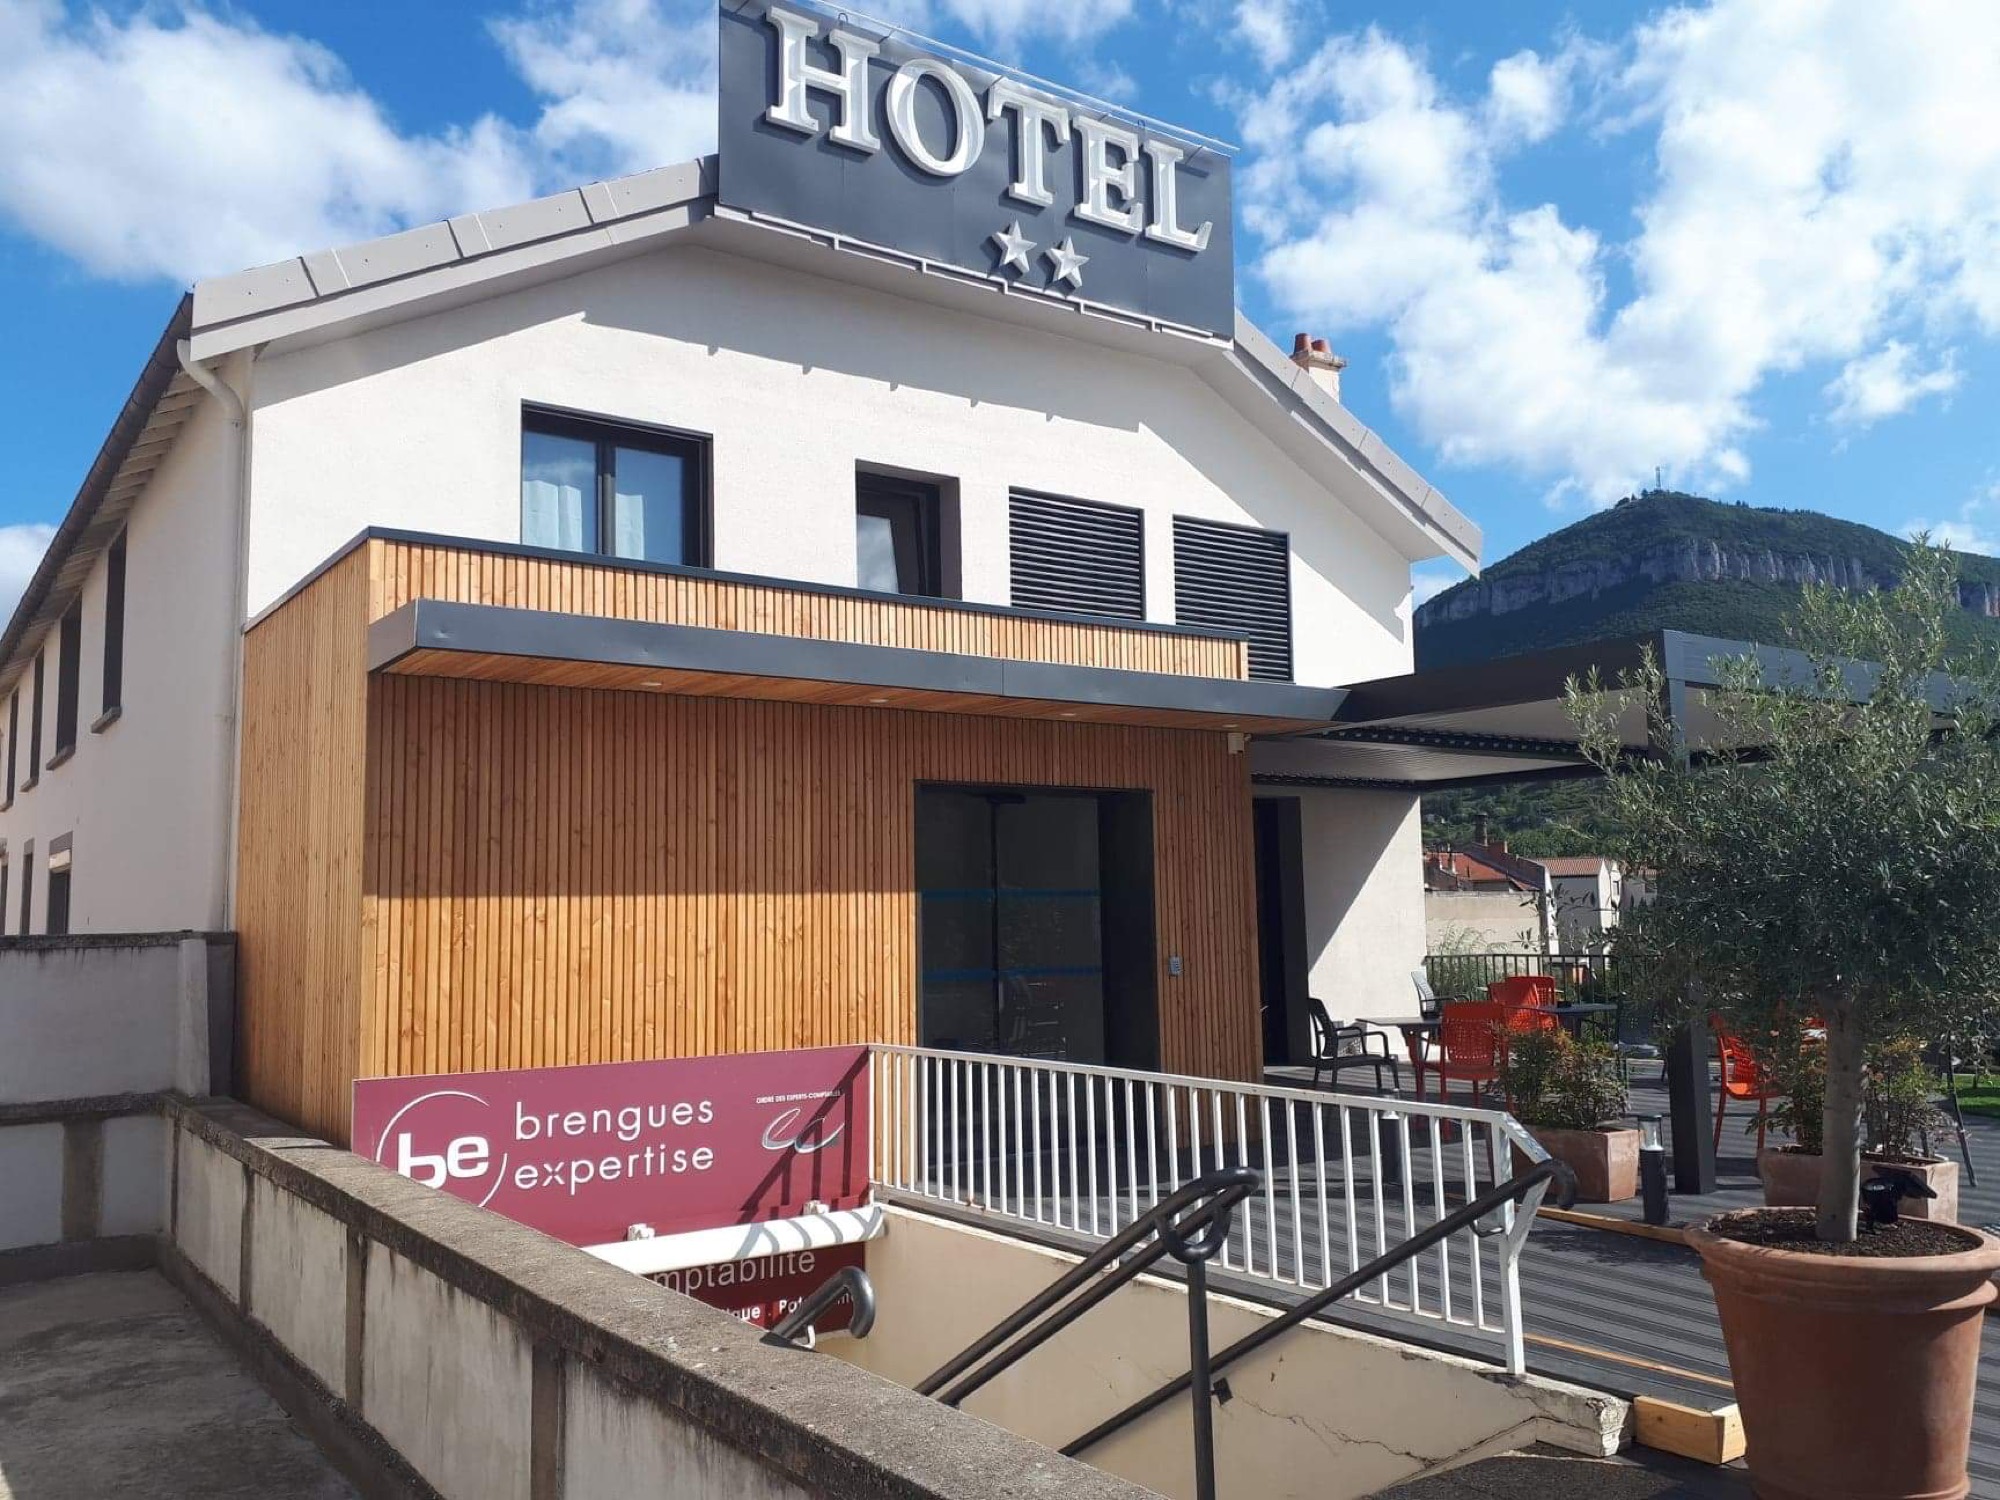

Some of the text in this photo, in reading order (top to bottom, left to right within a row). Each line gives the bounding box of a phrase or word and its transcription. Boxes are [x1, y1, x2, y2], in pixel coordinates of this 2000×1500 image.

[765, 5, 1214, 252] HOTEL
[515, 1101, 714, 1141] brengues
[398, 1133, 489, 1190] be
[515, 1144, 714, 1195] expertise
